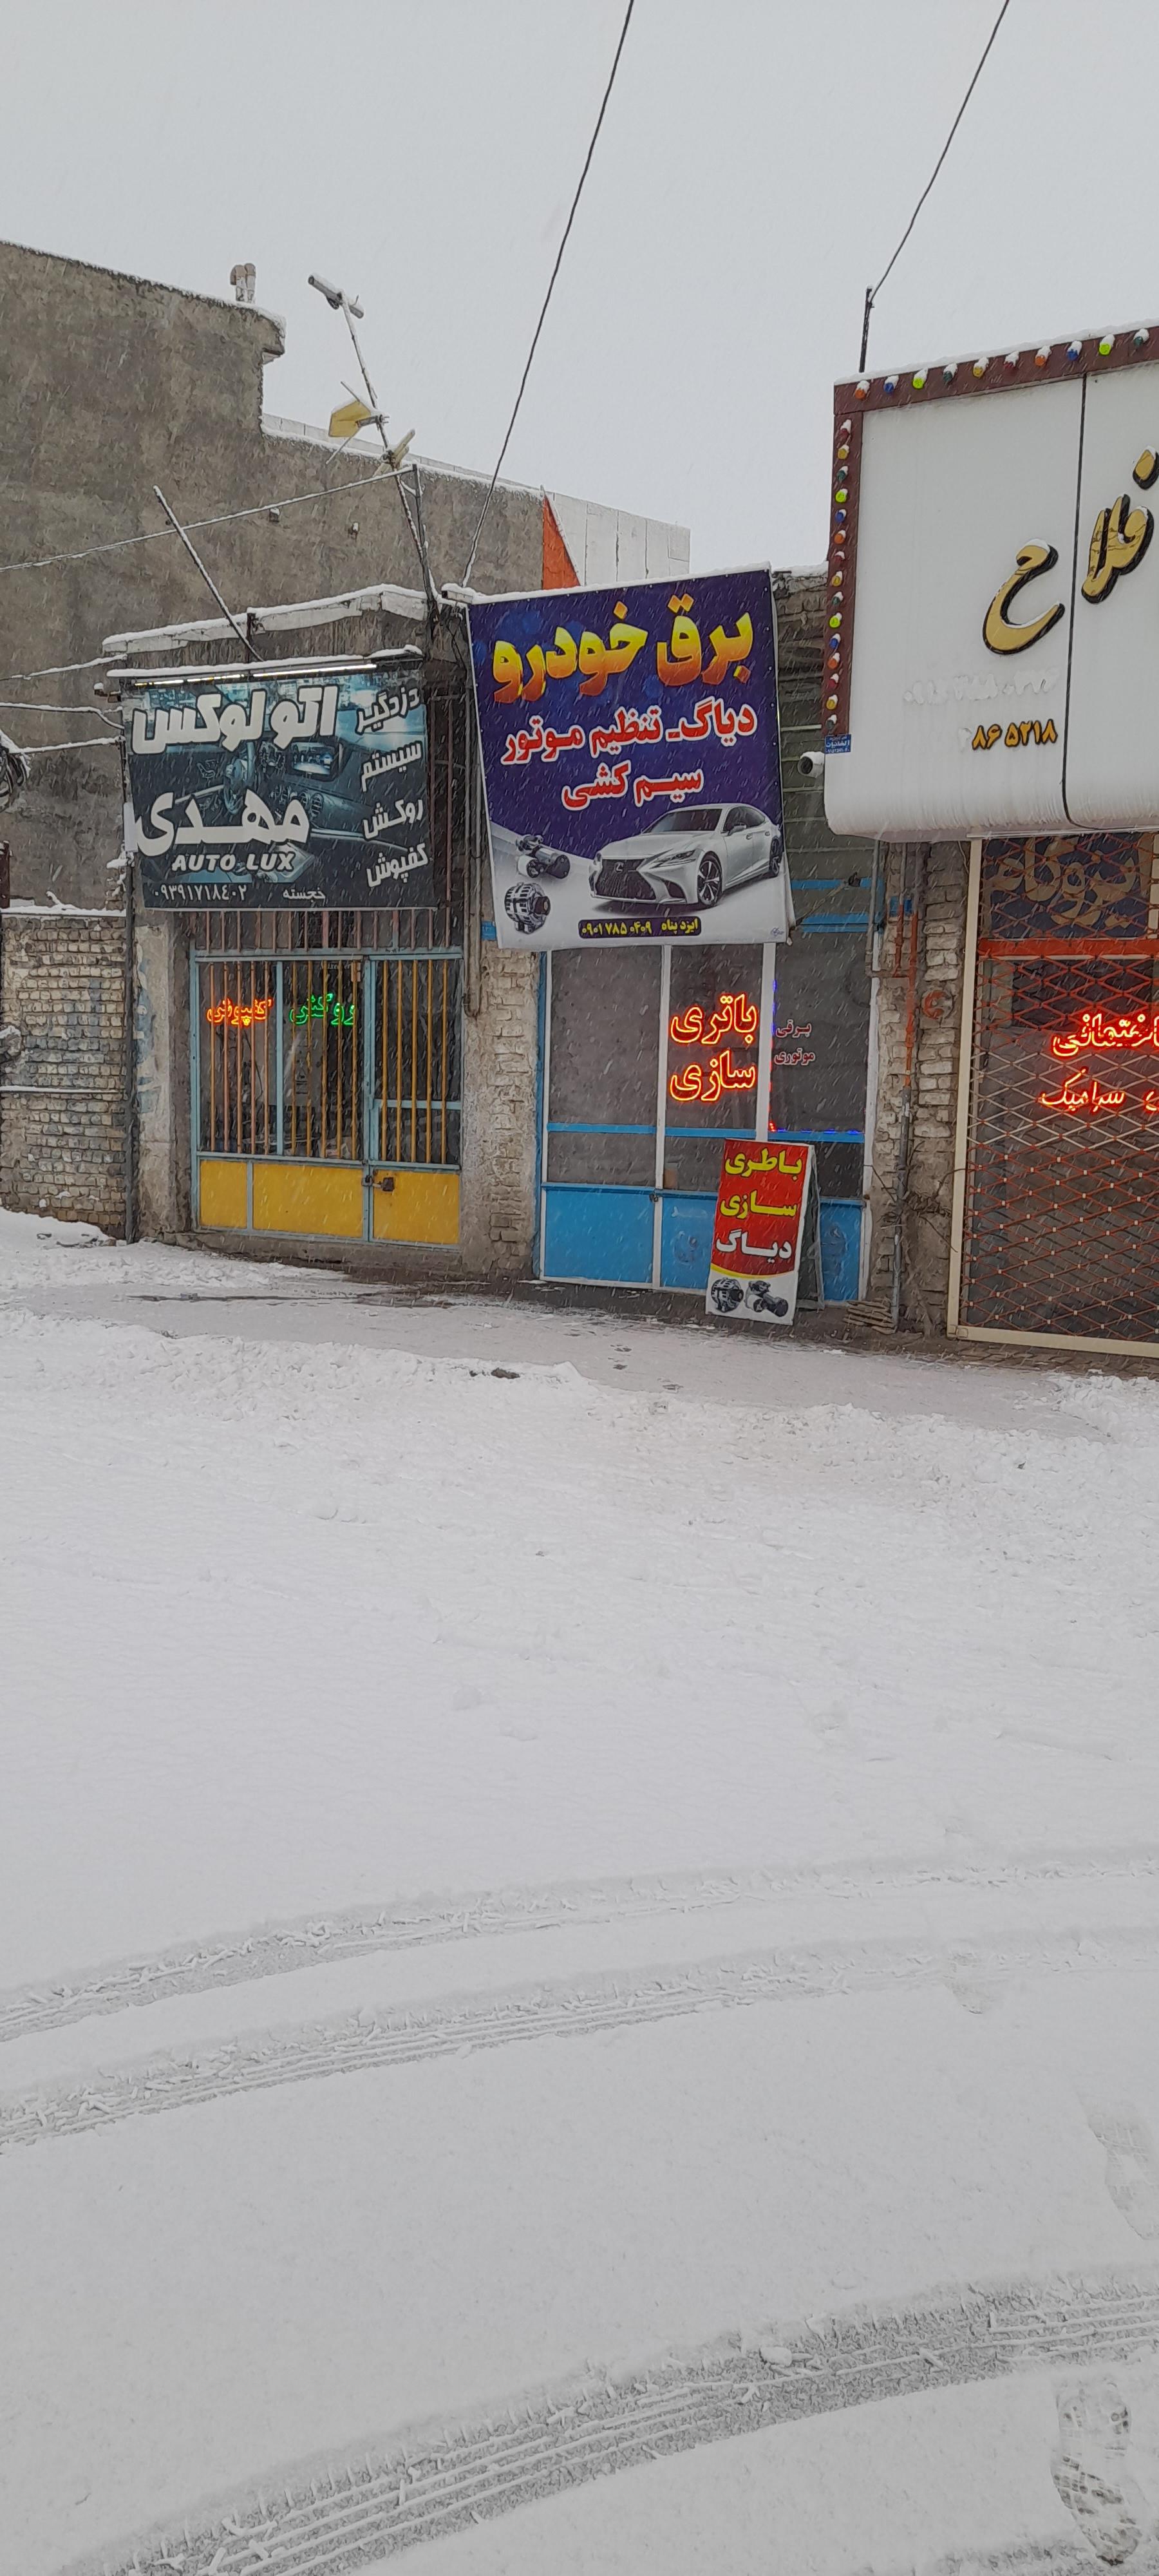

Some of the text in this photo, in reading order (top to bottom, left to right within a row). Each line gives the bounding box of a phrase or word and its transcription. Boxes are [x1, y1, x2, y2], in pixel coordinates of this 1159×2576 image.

[493, 593, 753, 703] برق خودرو
[131, 684, 339, 755] اتو لوکس
[355, 686, 420, 735] دزدگیر
[590, 705, 664, 757] تنظیم
[501, 716, 585, 764] موتور
[361, 741, 422, 792] سیستم
[561, 761, 703, 810] سیم کشی
[134, 790, 312, 857] مهدی
[363, 799, 424, 839] روکش
[171, 851, 296, 873] AUTO LUX
[366, 842, 429, 887] کفپوش
[581, 918, 699, 936] ایزد پناه ۰۹۰۱ ۷۸۵ ۰۴۰۹
[670, 992, 758, 1045] باتری
[776, 1019, 812, 1037] برقی
[670, 1050, 757, 1102] سازی
[774, 1048, 816, 1066] موتوری
[1041, 1068, 1126, 1112] سرامیک
[724, 1148, 803, 1182] باطری
[719, 1190, 798, 1218] سازی
[715, 1229, 793, 1264] دیاگ
